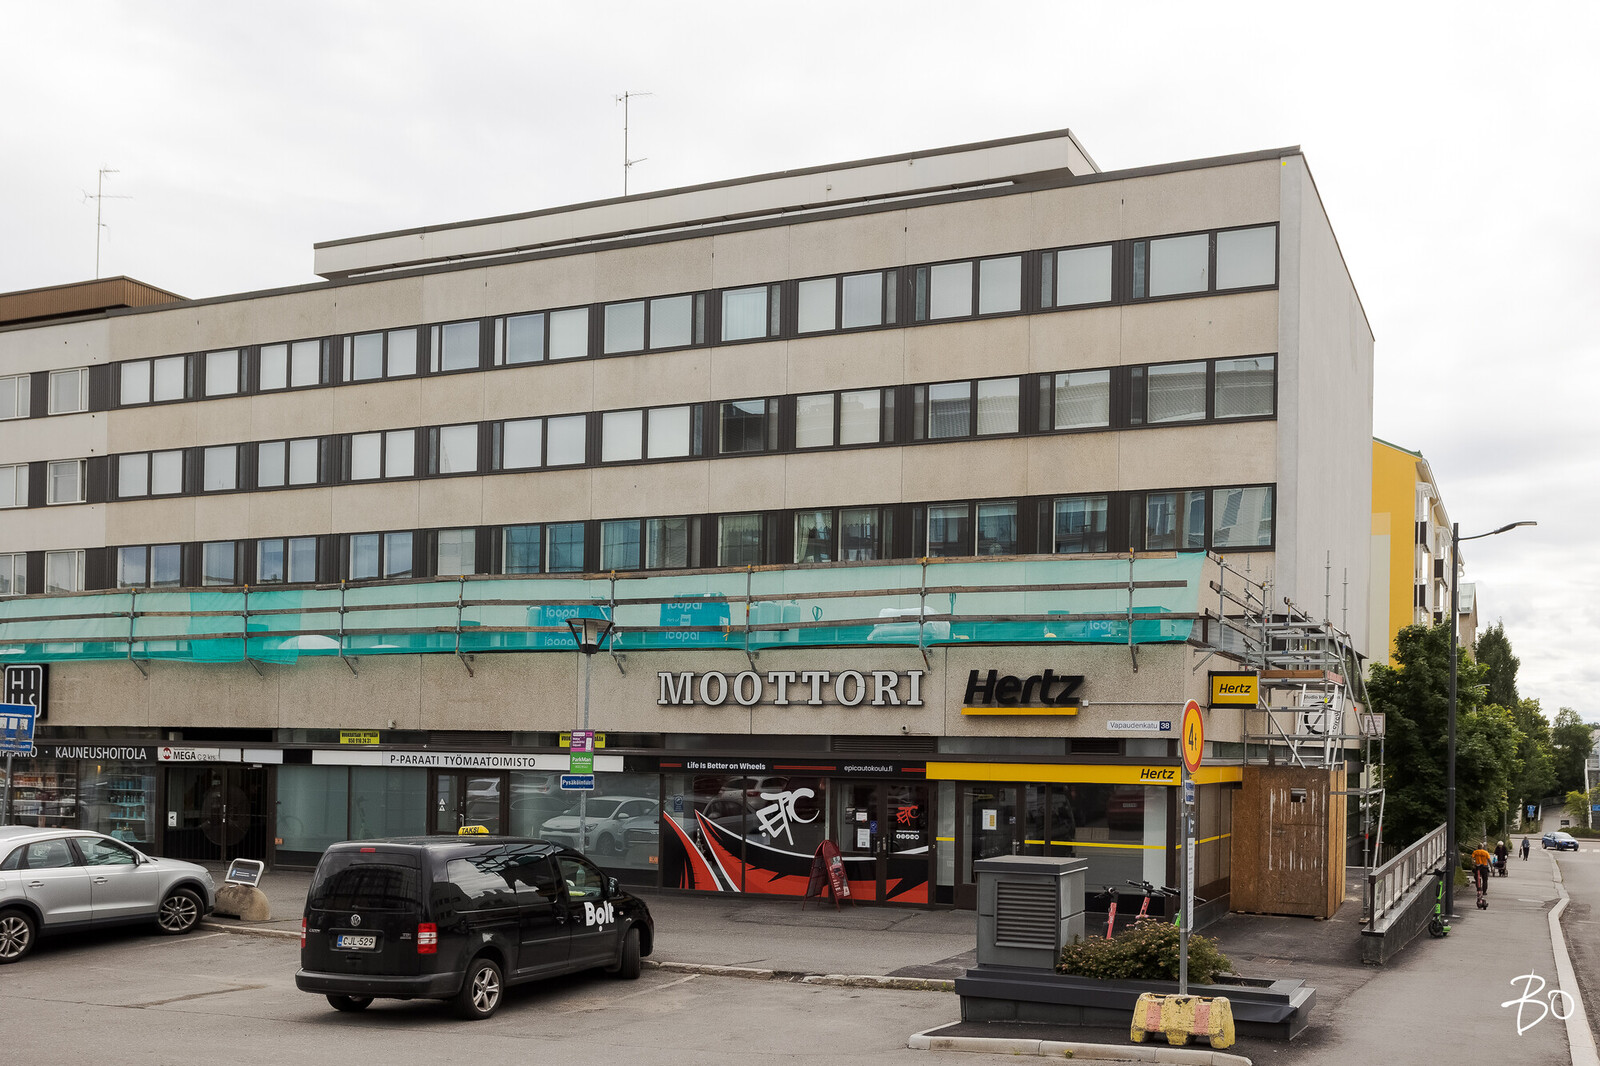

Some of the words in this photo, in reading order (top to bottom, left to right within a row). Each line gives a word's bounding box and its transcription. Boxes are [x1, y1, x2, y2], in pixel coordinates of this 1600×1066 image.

[657, 669, 924, 707] MOOTTORI
[963, 668, 1085, 705] Hertz
[1218, 683, 1252, 694] Hertz
[1109, 721, 1158, 730] Vapaudenkatu
[55, 746, 147, 760] KAUNEUSHOITOLA
[173, 751, 196, 760] MEGA
[390, 754, 440, 765] P-PARAATI
[444, 753, 536, 767] TYÖMAATOIMISTO
[686, 761, 700, 769] Life
[707, 762, 728, 770] Better
[739, 762, 766, 771] Wheels
[844, 765, 893, 773] epicautokoulu.fi
[1140, 768, 1175, 779] Hertz
[461, 826, 480, 834] TAKSI
[584, 900, 615, 931] Bolt
[342, 937, 374, 946] CJL-529
